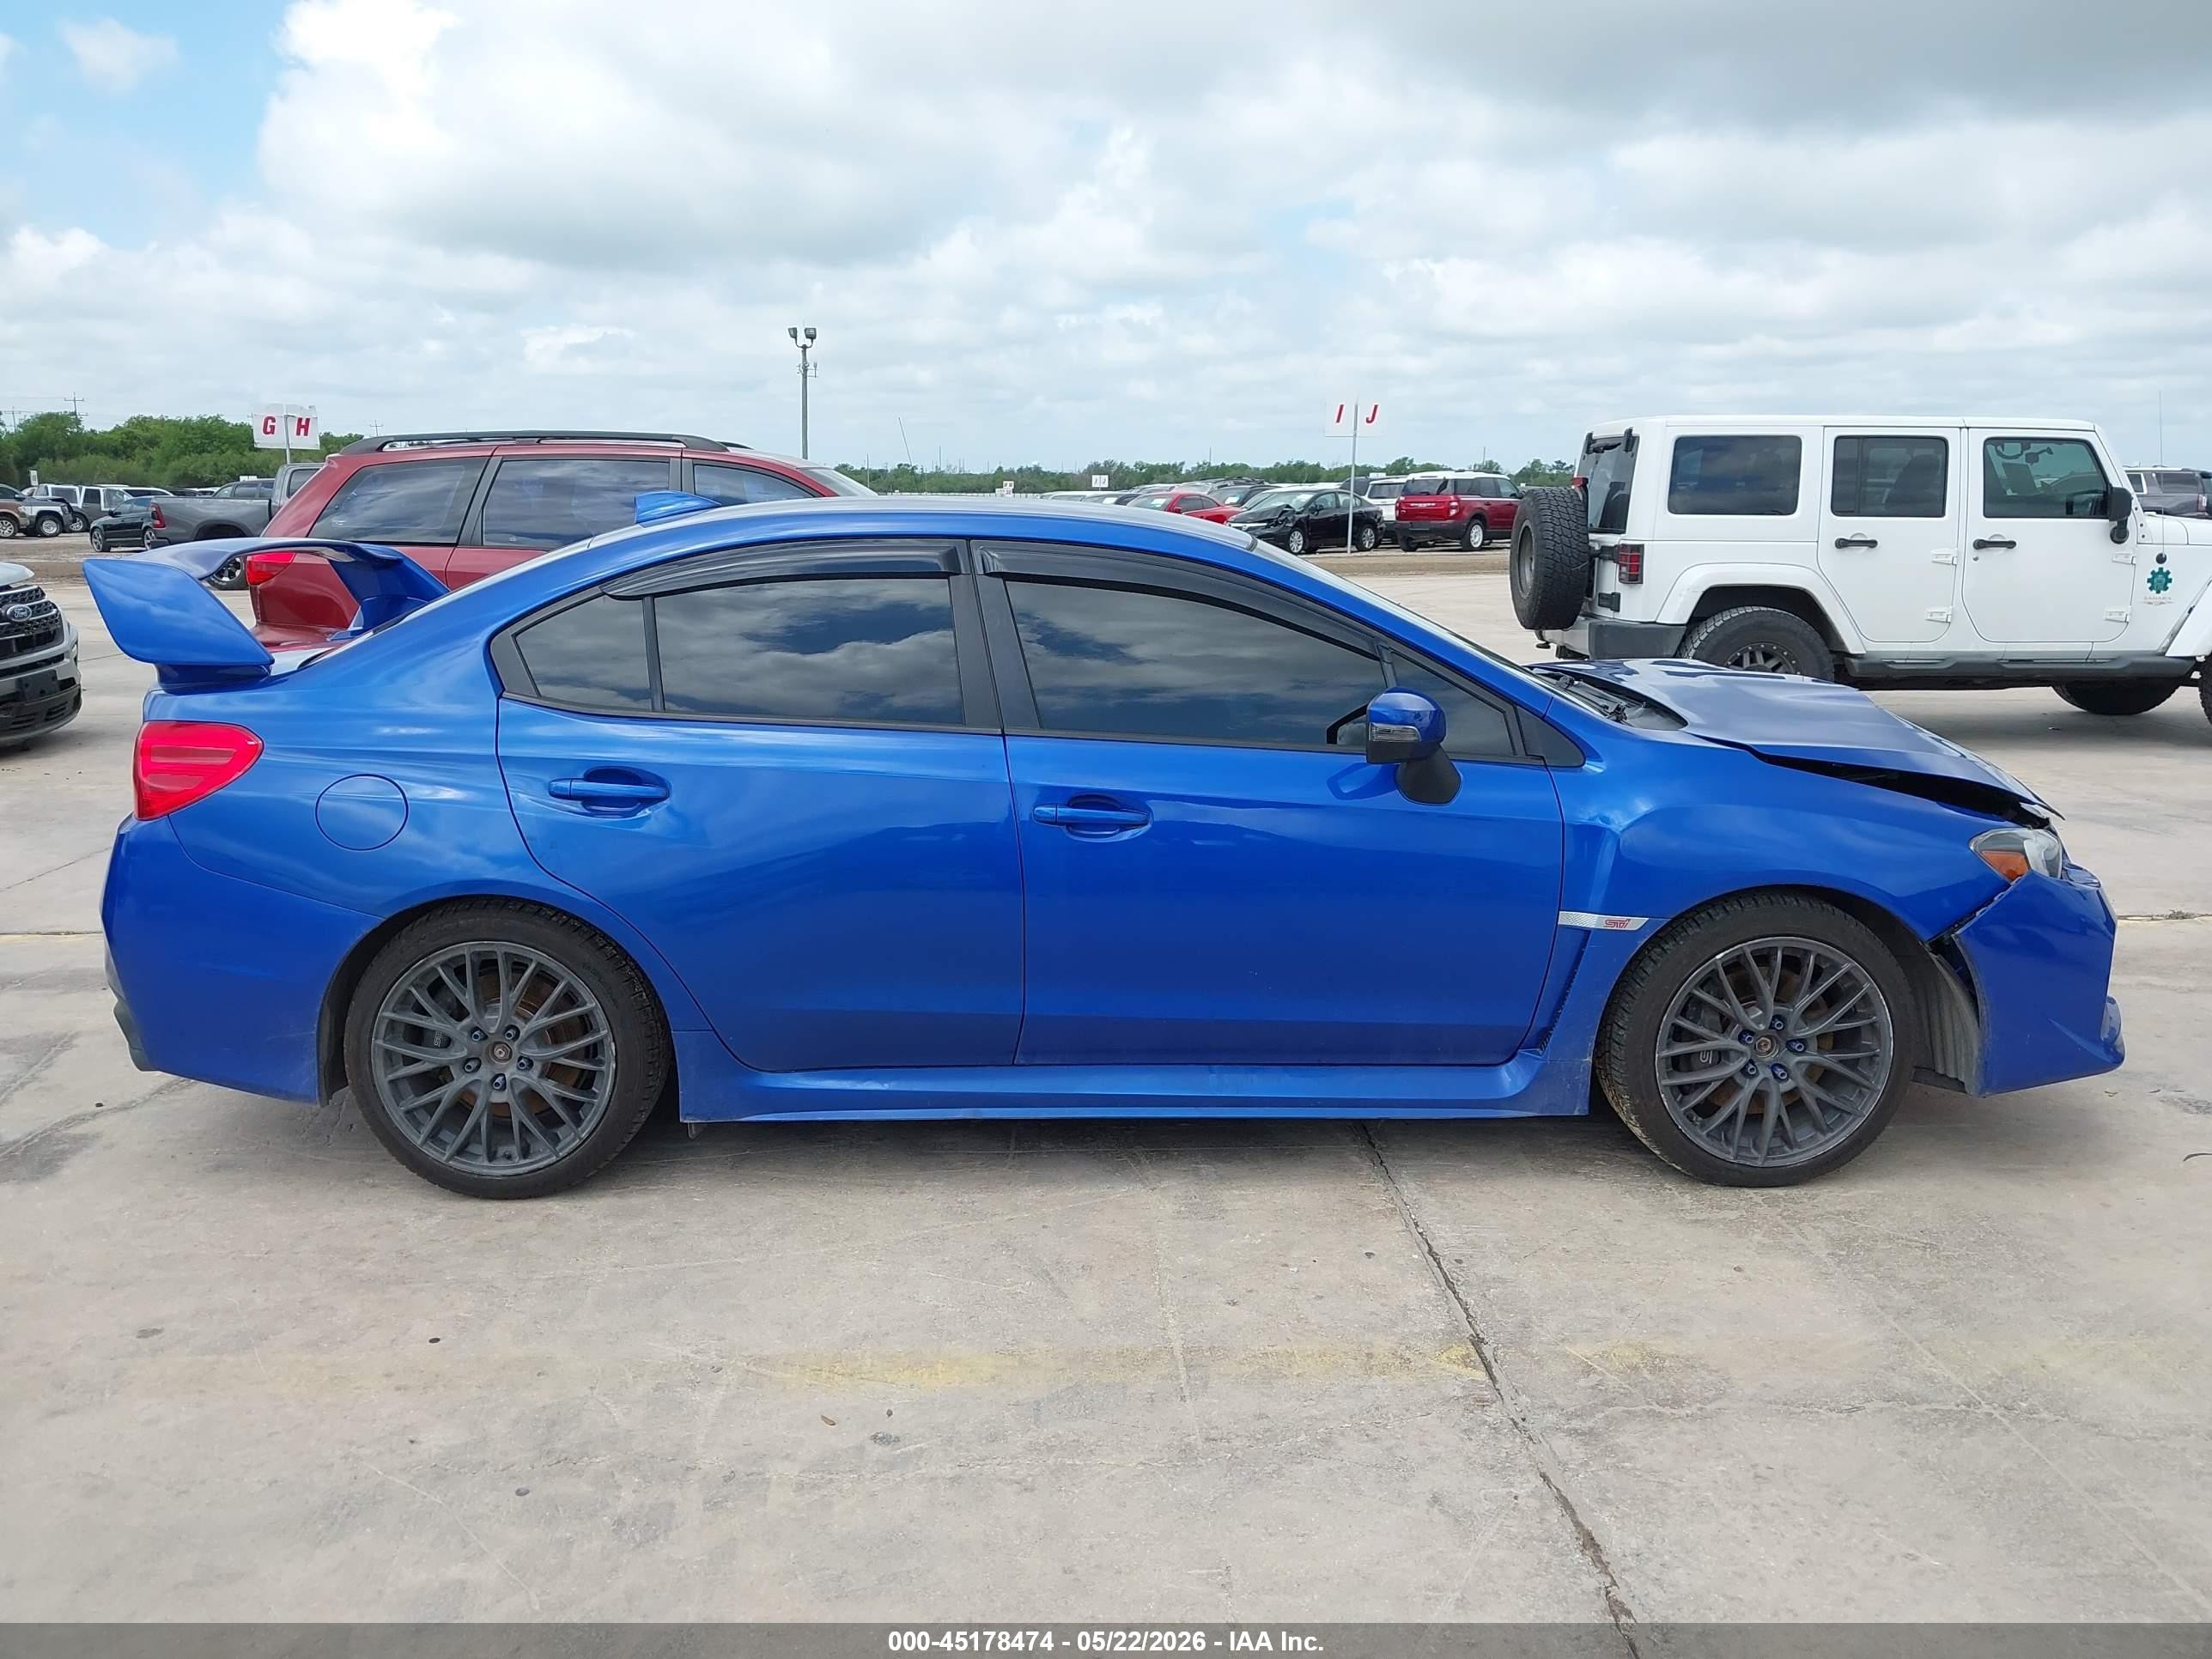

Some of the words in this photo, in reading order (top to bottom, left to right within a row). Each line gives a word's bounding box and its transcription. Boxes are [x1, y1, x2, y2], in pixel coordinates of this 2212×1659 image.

[1335, 404, 1345, 423] I
[1365, 404, 1379, 424] J
[263, 416, 276, 435] G
[295, 416, 311, 437] H
